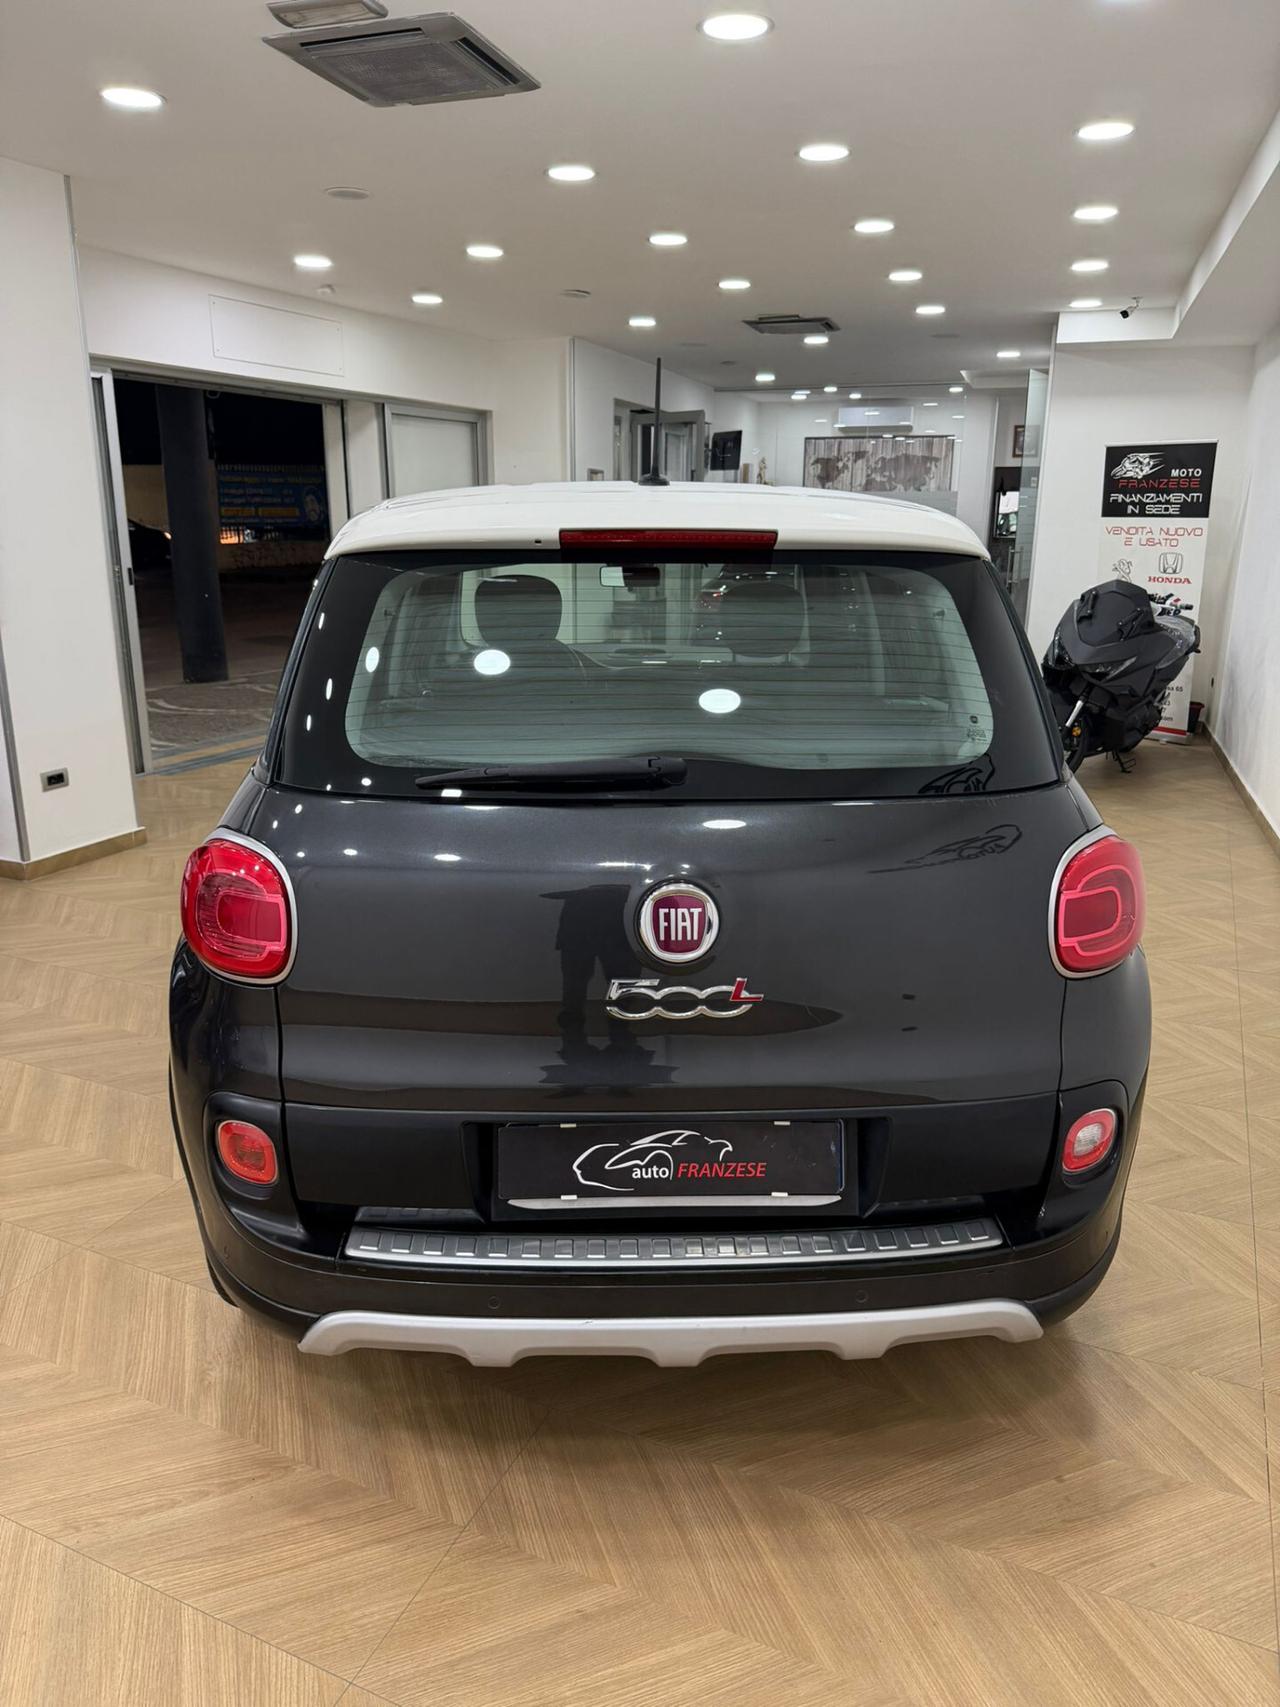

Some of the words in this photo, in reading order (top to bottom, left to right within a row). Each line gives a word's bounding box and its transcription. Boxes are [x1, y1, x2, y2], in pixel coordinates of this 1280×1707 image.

[1171, 468, 1202, 478] MOTO
[1118, 478, 1201, 489] FRANZESE
[1109, 493, 1203, 503] FINANZIAMENTI
[1127, 505, 1139, 514] IN
[1145, 504, 1181, 515] SEDE
[1105, 526, 1154, 535] VENDITA
[1159, 526, 1204, 537] NUOVO
[1124, 537, 1133, 546] E
[1139, 537, 1179, 547] USATO
[1147, 576, 1192, 584] HONDA
[658, 907, 703, 941] FIAT
[606, 977, 764, 1020] 500L
[631, 1164, 670, 1179] auto
[676, 1162, 767, 1178] FRANZESE
